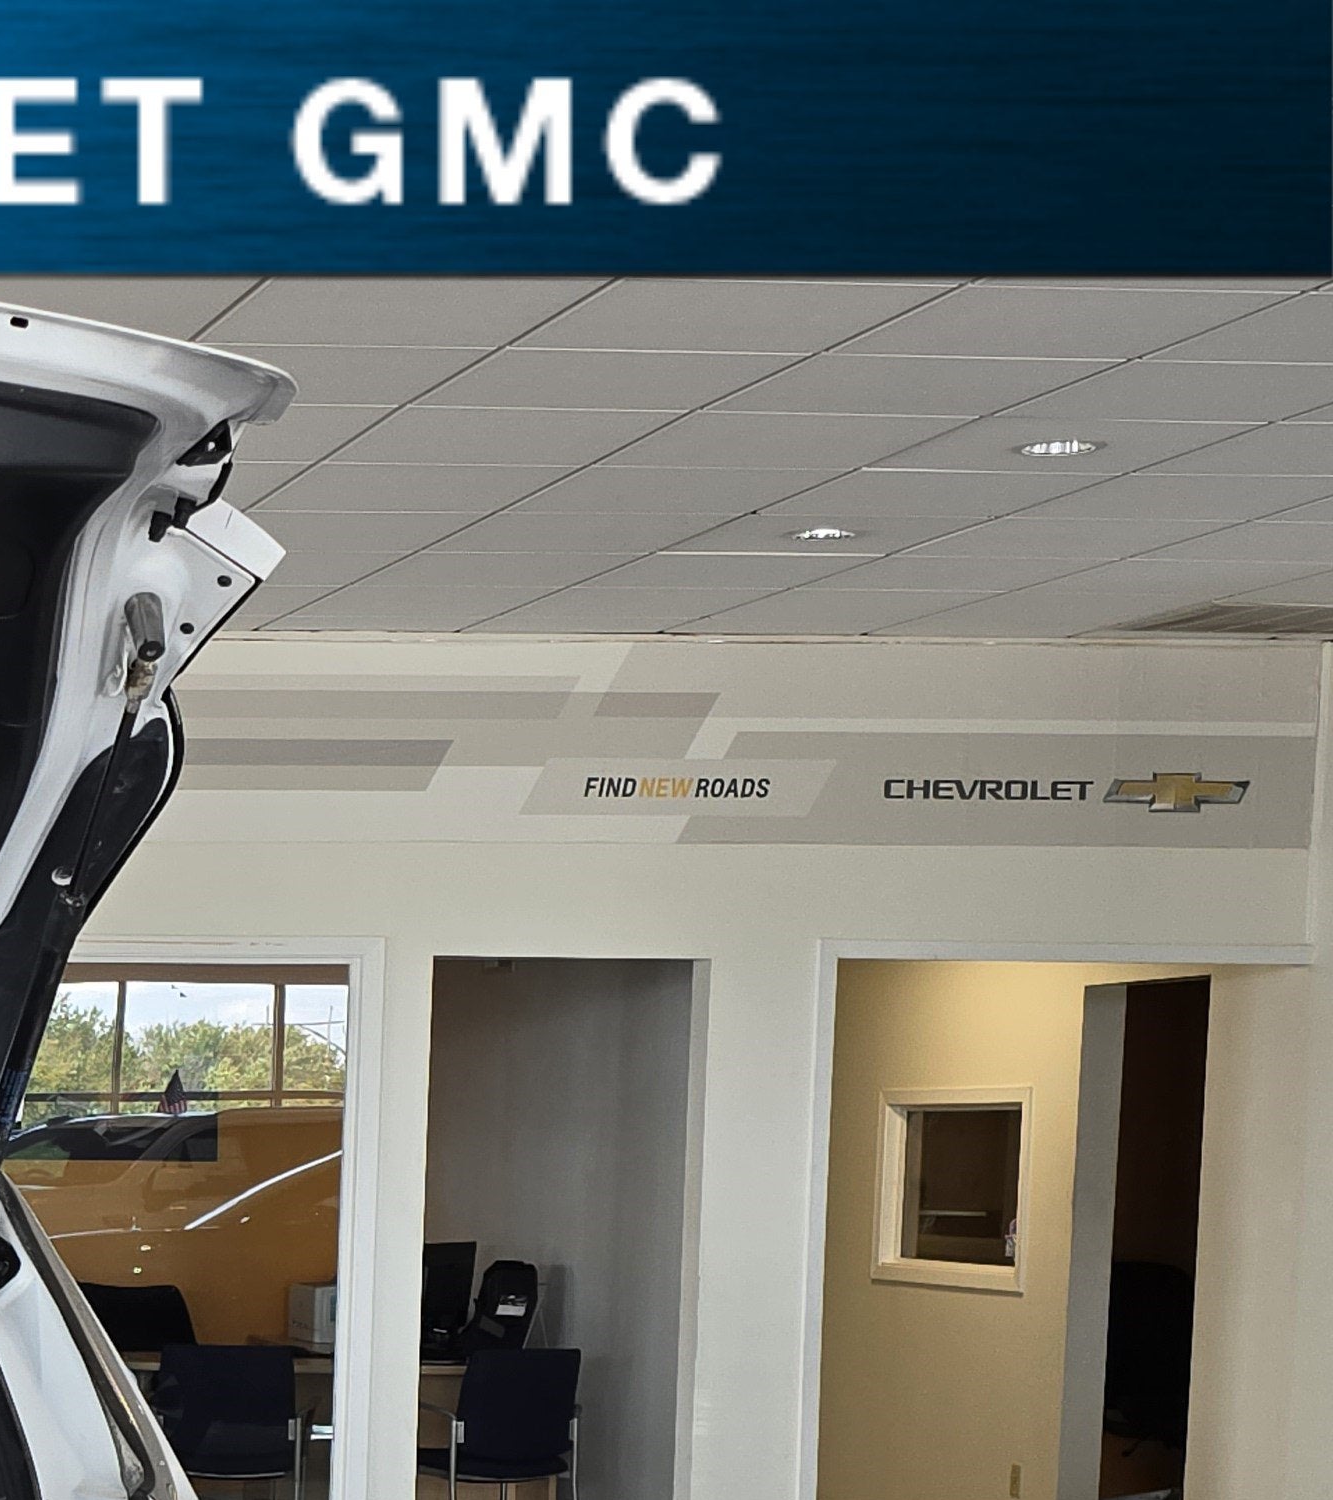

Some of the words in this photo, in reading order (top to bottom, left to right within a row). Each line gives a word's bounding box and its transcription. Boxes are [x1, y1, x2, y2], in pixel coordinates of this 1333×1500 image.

[584, 777, 637, 798] FIND
[638, 777, 694, 798] NEW
[694, 778, 771, 799] ROADS
[883, 779, 1095, 801] CHEVROLET
